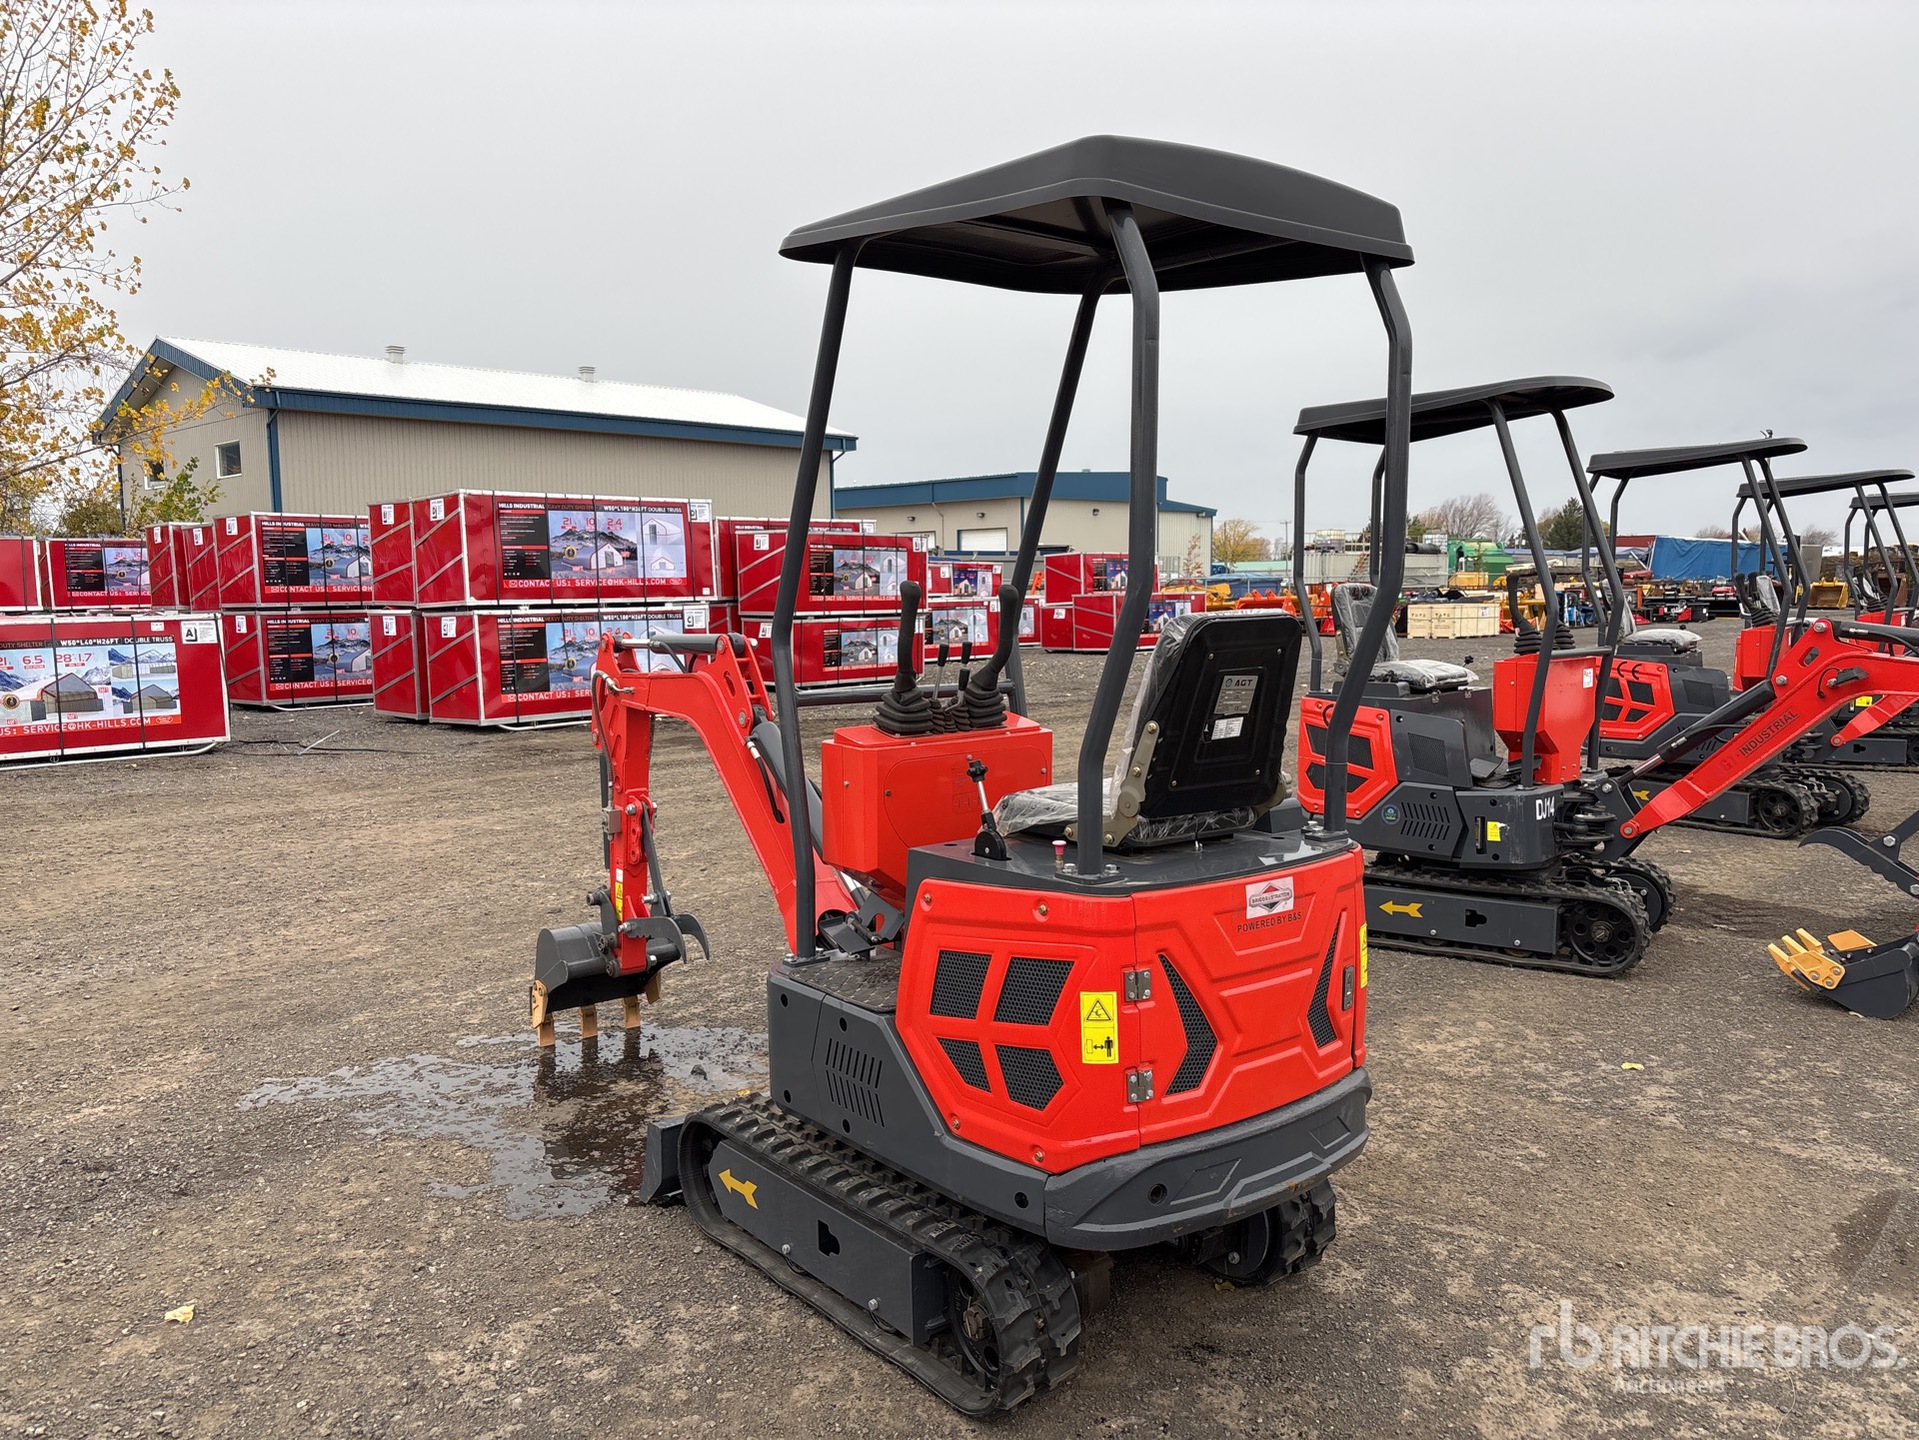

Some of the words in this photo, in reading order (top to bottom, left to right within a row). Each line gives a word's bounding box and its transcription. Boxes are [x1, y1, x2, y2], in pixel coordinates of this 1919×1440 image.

[185, 629, 194, 637] A
[17, 640, 44, 648] SHELTER
[152, 635, 174, 643] TRUSS
[1233, 679, 1254, 687] AGT
[517, 691, 554, 702] CONTACT
[1739, 709, 1800, 758] INDUSTRIAL
[1535, 796, 1555, 821] DJ14
[1237, 917, 1276, 933] POWERED
[1276, 915, 1288, 925] BY
[1288, 912, 1302, 922] B&S
